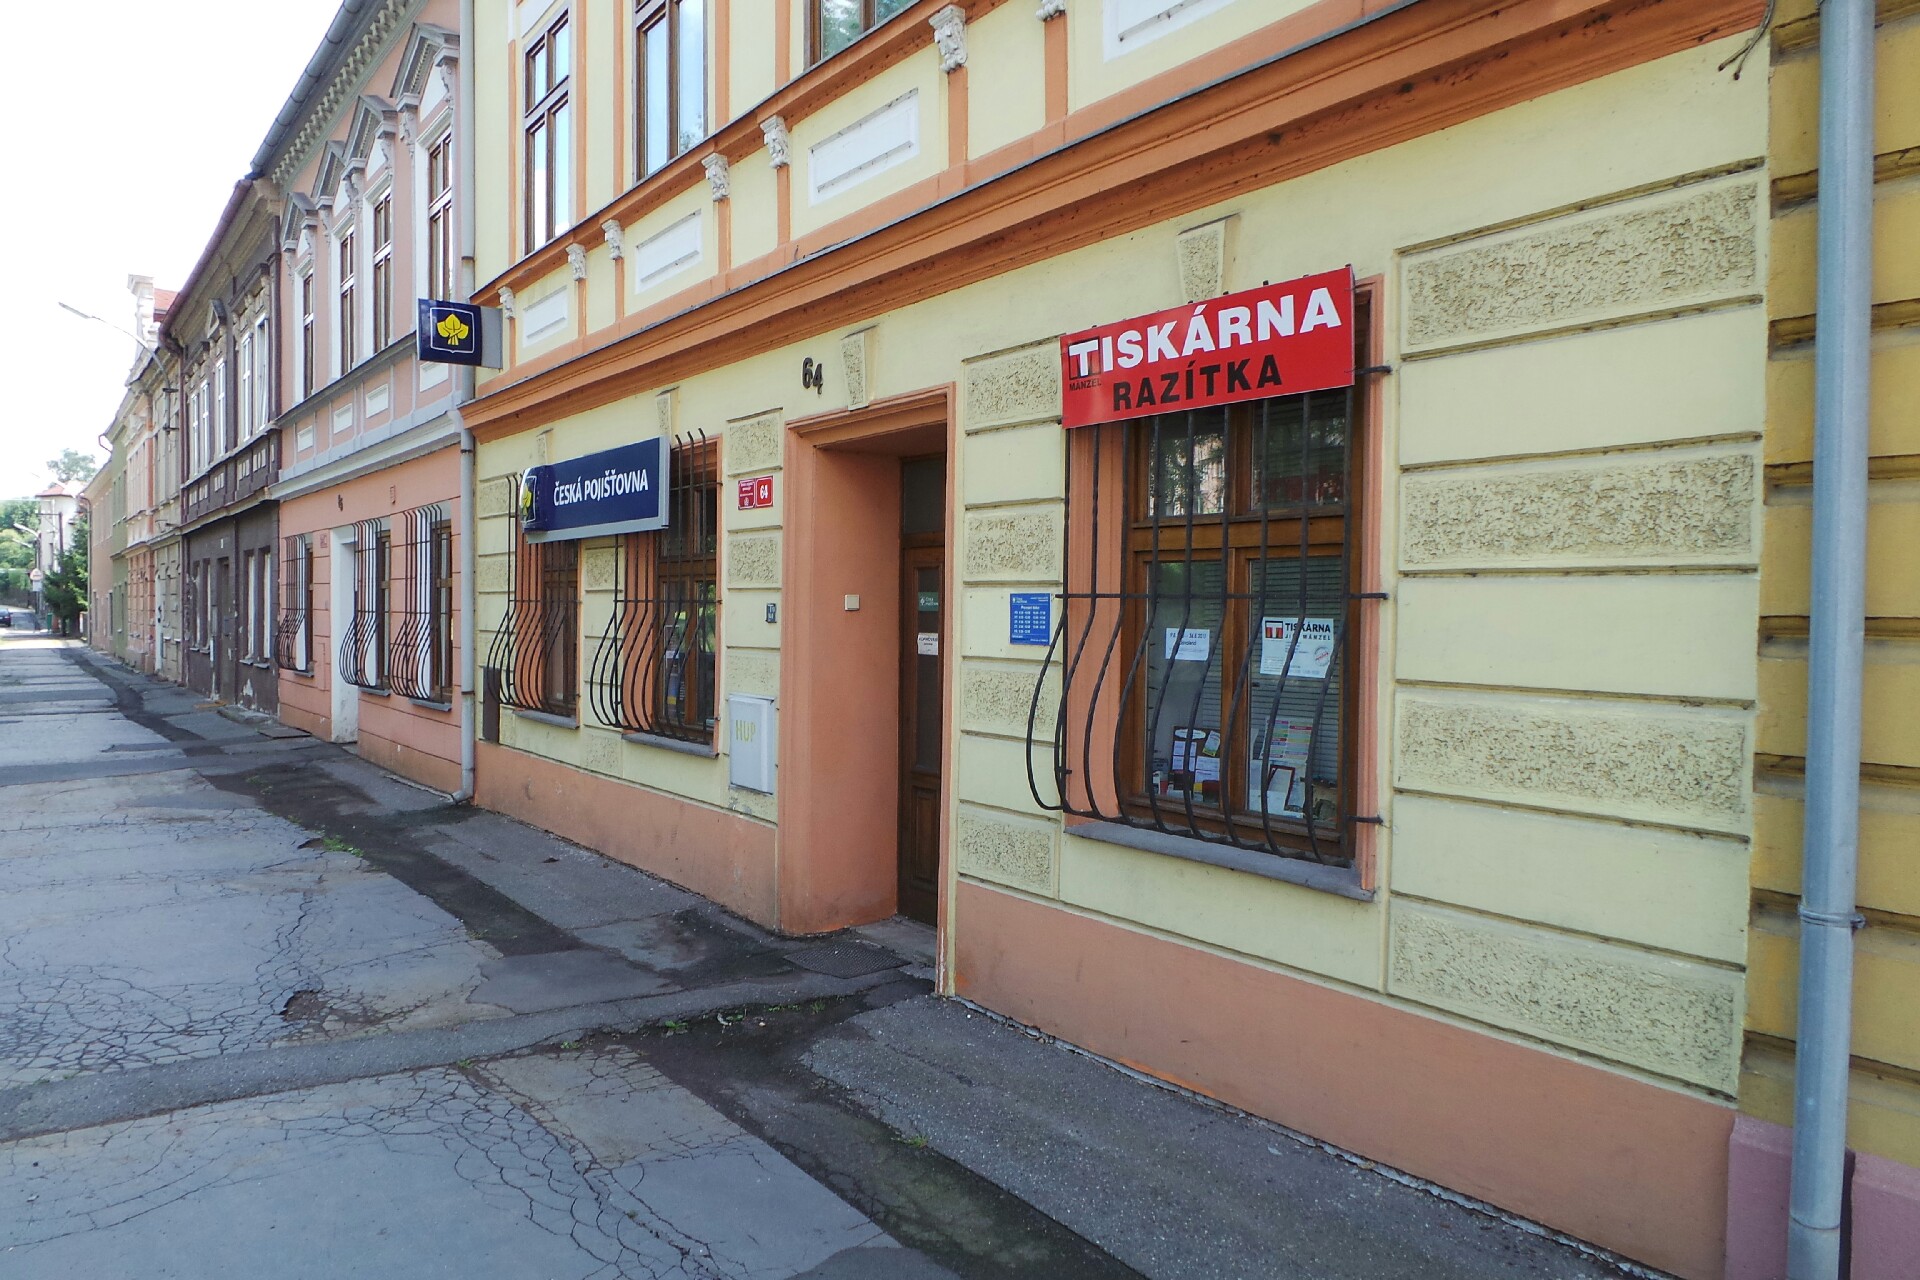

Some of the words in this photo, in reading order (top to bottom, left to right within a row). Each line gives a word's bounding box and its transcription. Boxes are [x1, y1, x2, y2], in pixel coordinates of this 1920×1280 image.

[1068, 286, 1342, 378] TISKÁRNA
[802, 357, 823, 395] 64
[1112, 353, 1283, 412] RAZÍTKA
[553, 476, 583, 506] ČESKÁ
[584, 468, 649, 502] POJIŠŤOVNA
[759, 484, 769, 500] 64
[735, 719, 756, 742] HUP
